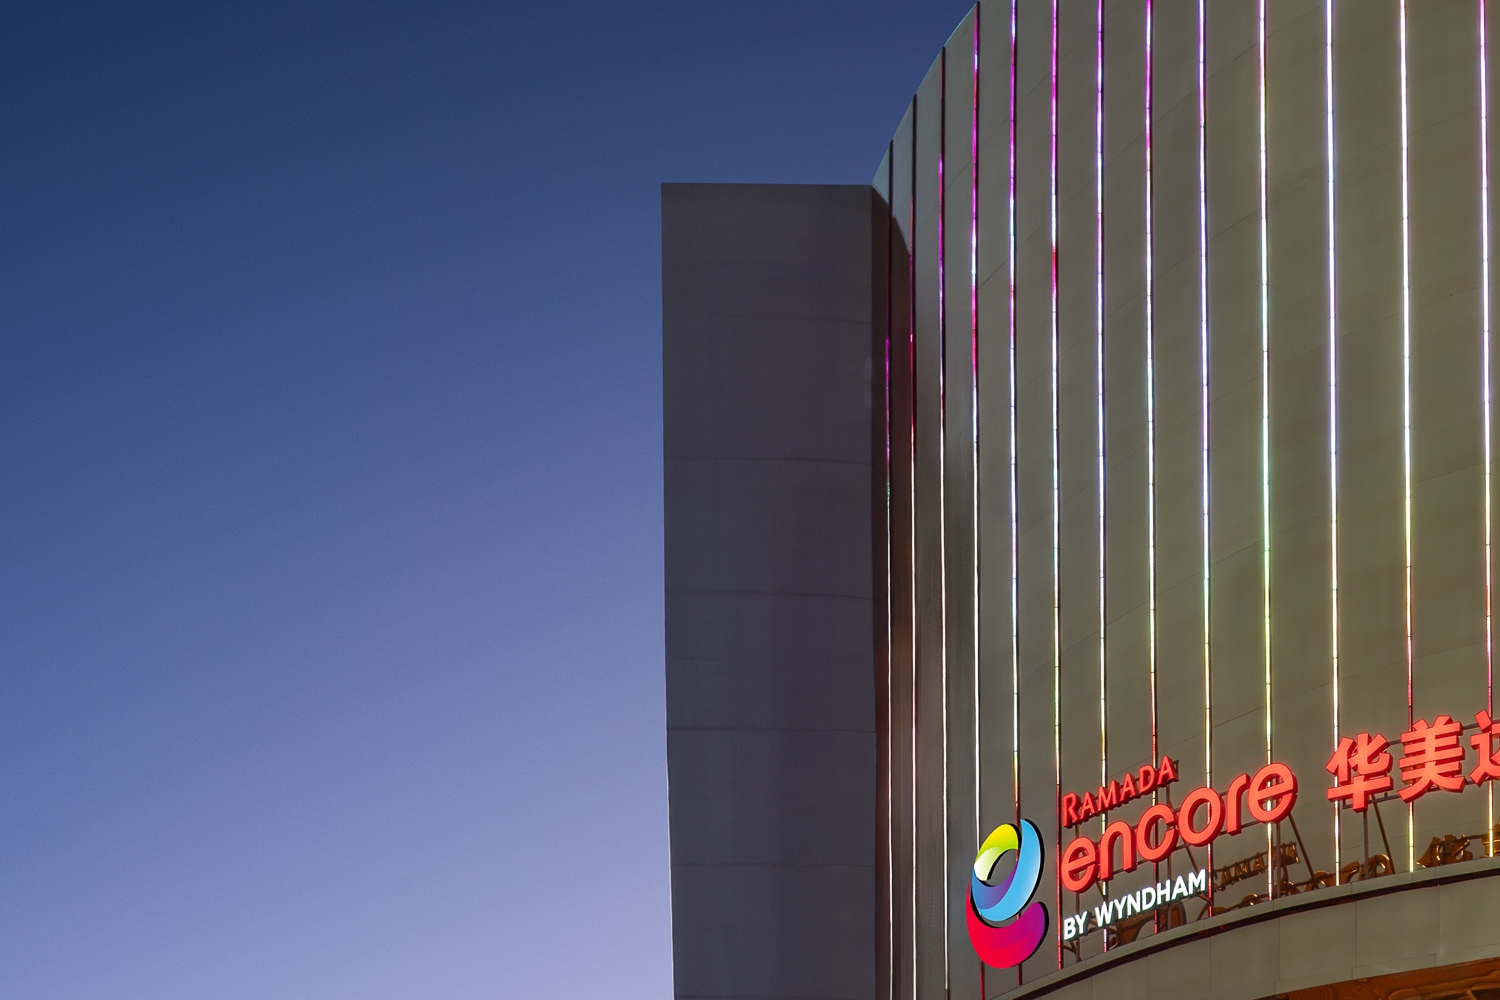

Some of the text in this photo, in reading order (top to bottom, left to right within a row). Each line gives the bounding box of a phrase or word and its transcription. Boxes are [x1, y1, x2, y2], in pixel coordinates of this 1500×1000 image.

[1061, 762, 1298, 894] encore
[1062, 755, 1180, 829] RAMADA
[1063, 910, 1090, 942] BY
[1094, 868, 1208, 927] WYNDHAM
